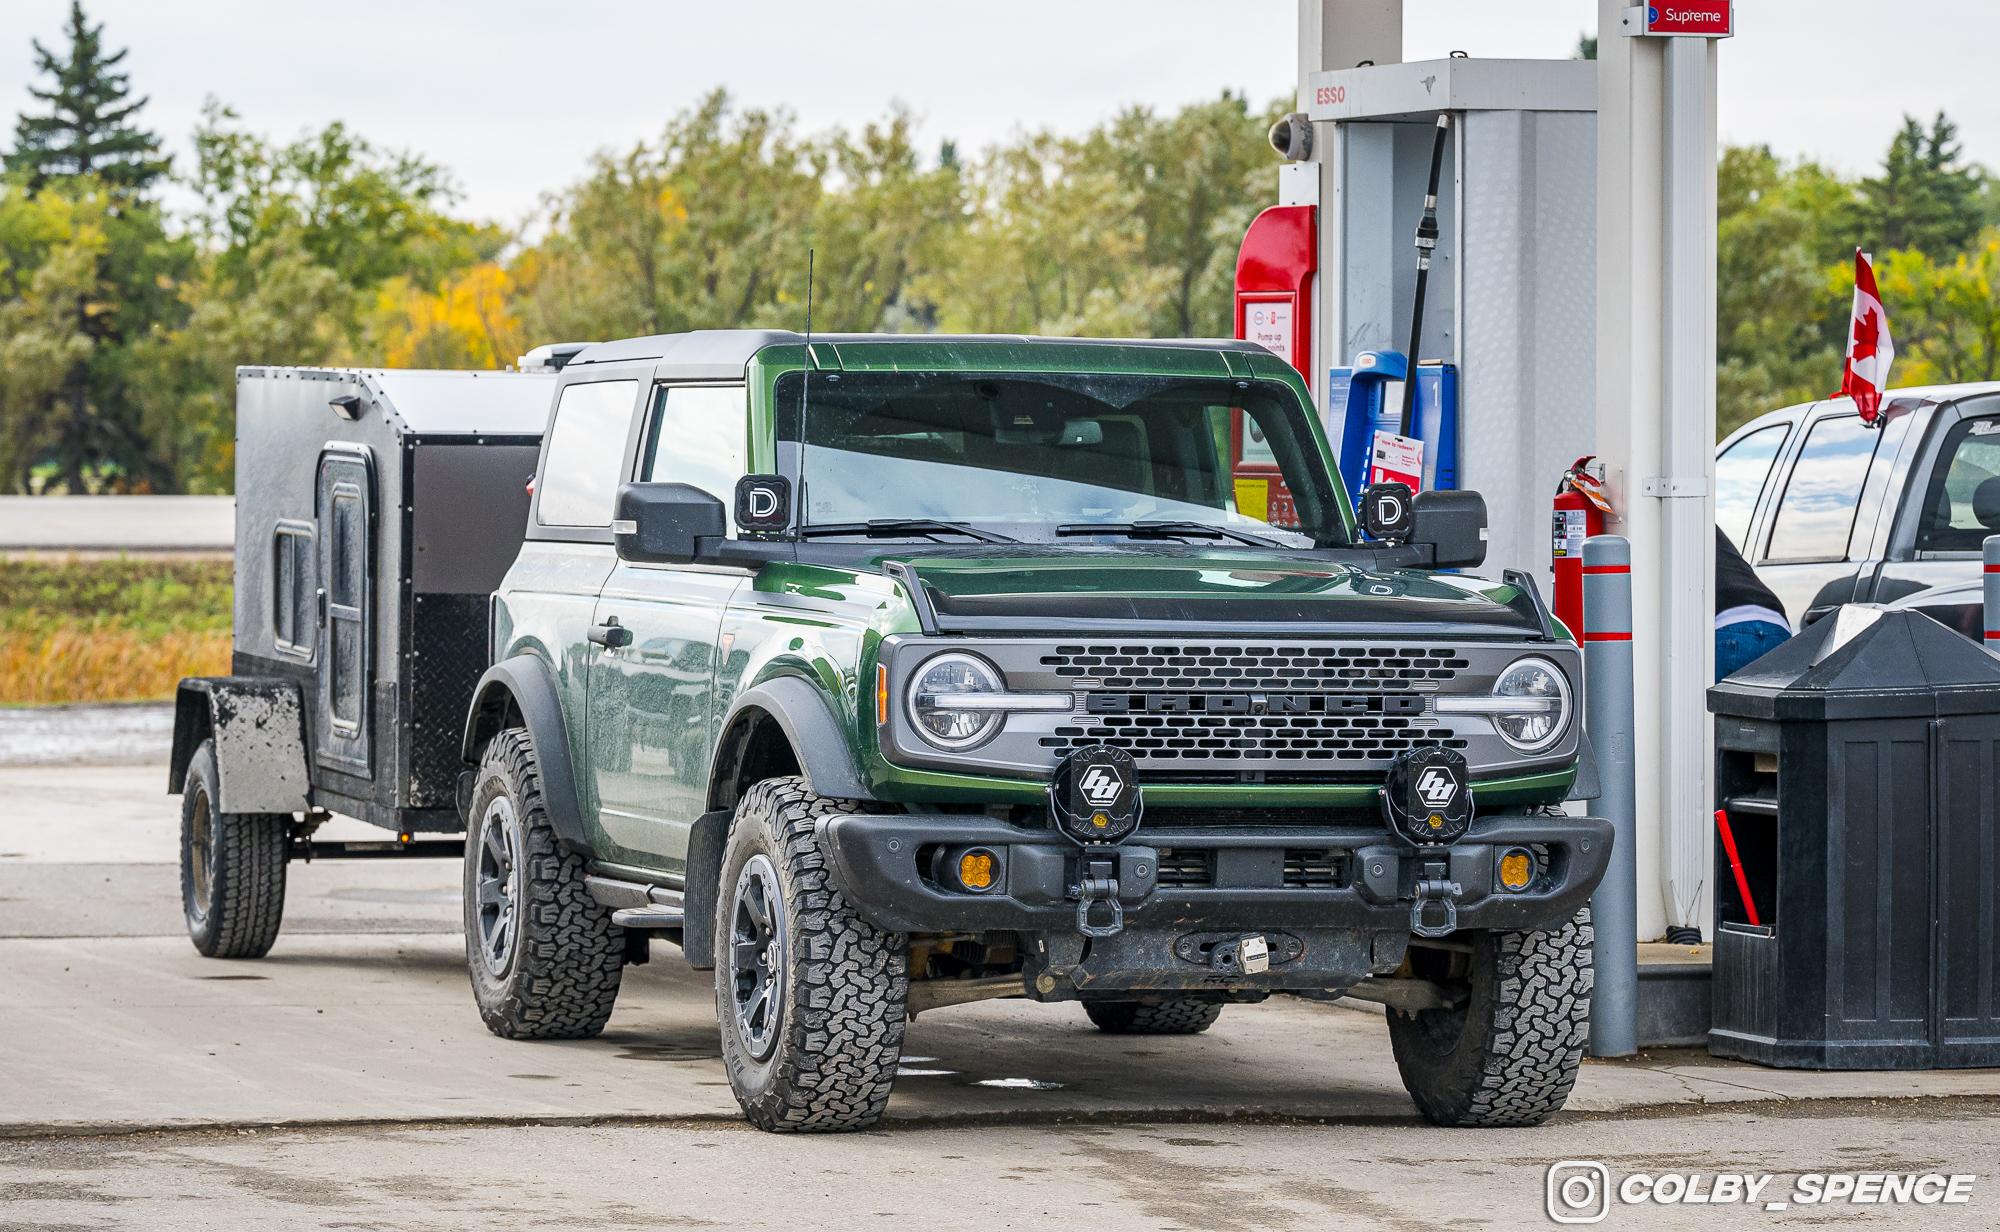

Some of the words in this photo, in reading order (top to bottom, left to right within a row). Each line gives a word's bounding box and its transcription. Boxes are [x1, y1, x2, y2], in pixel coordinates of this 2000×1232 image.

[1665, 8, 1721, 25] Supreme
[1316, 86, 1345, 105] ESSO
[1432, 381, 1438, 407] 1
[1087, 693, 1426, 713] BRONCO
